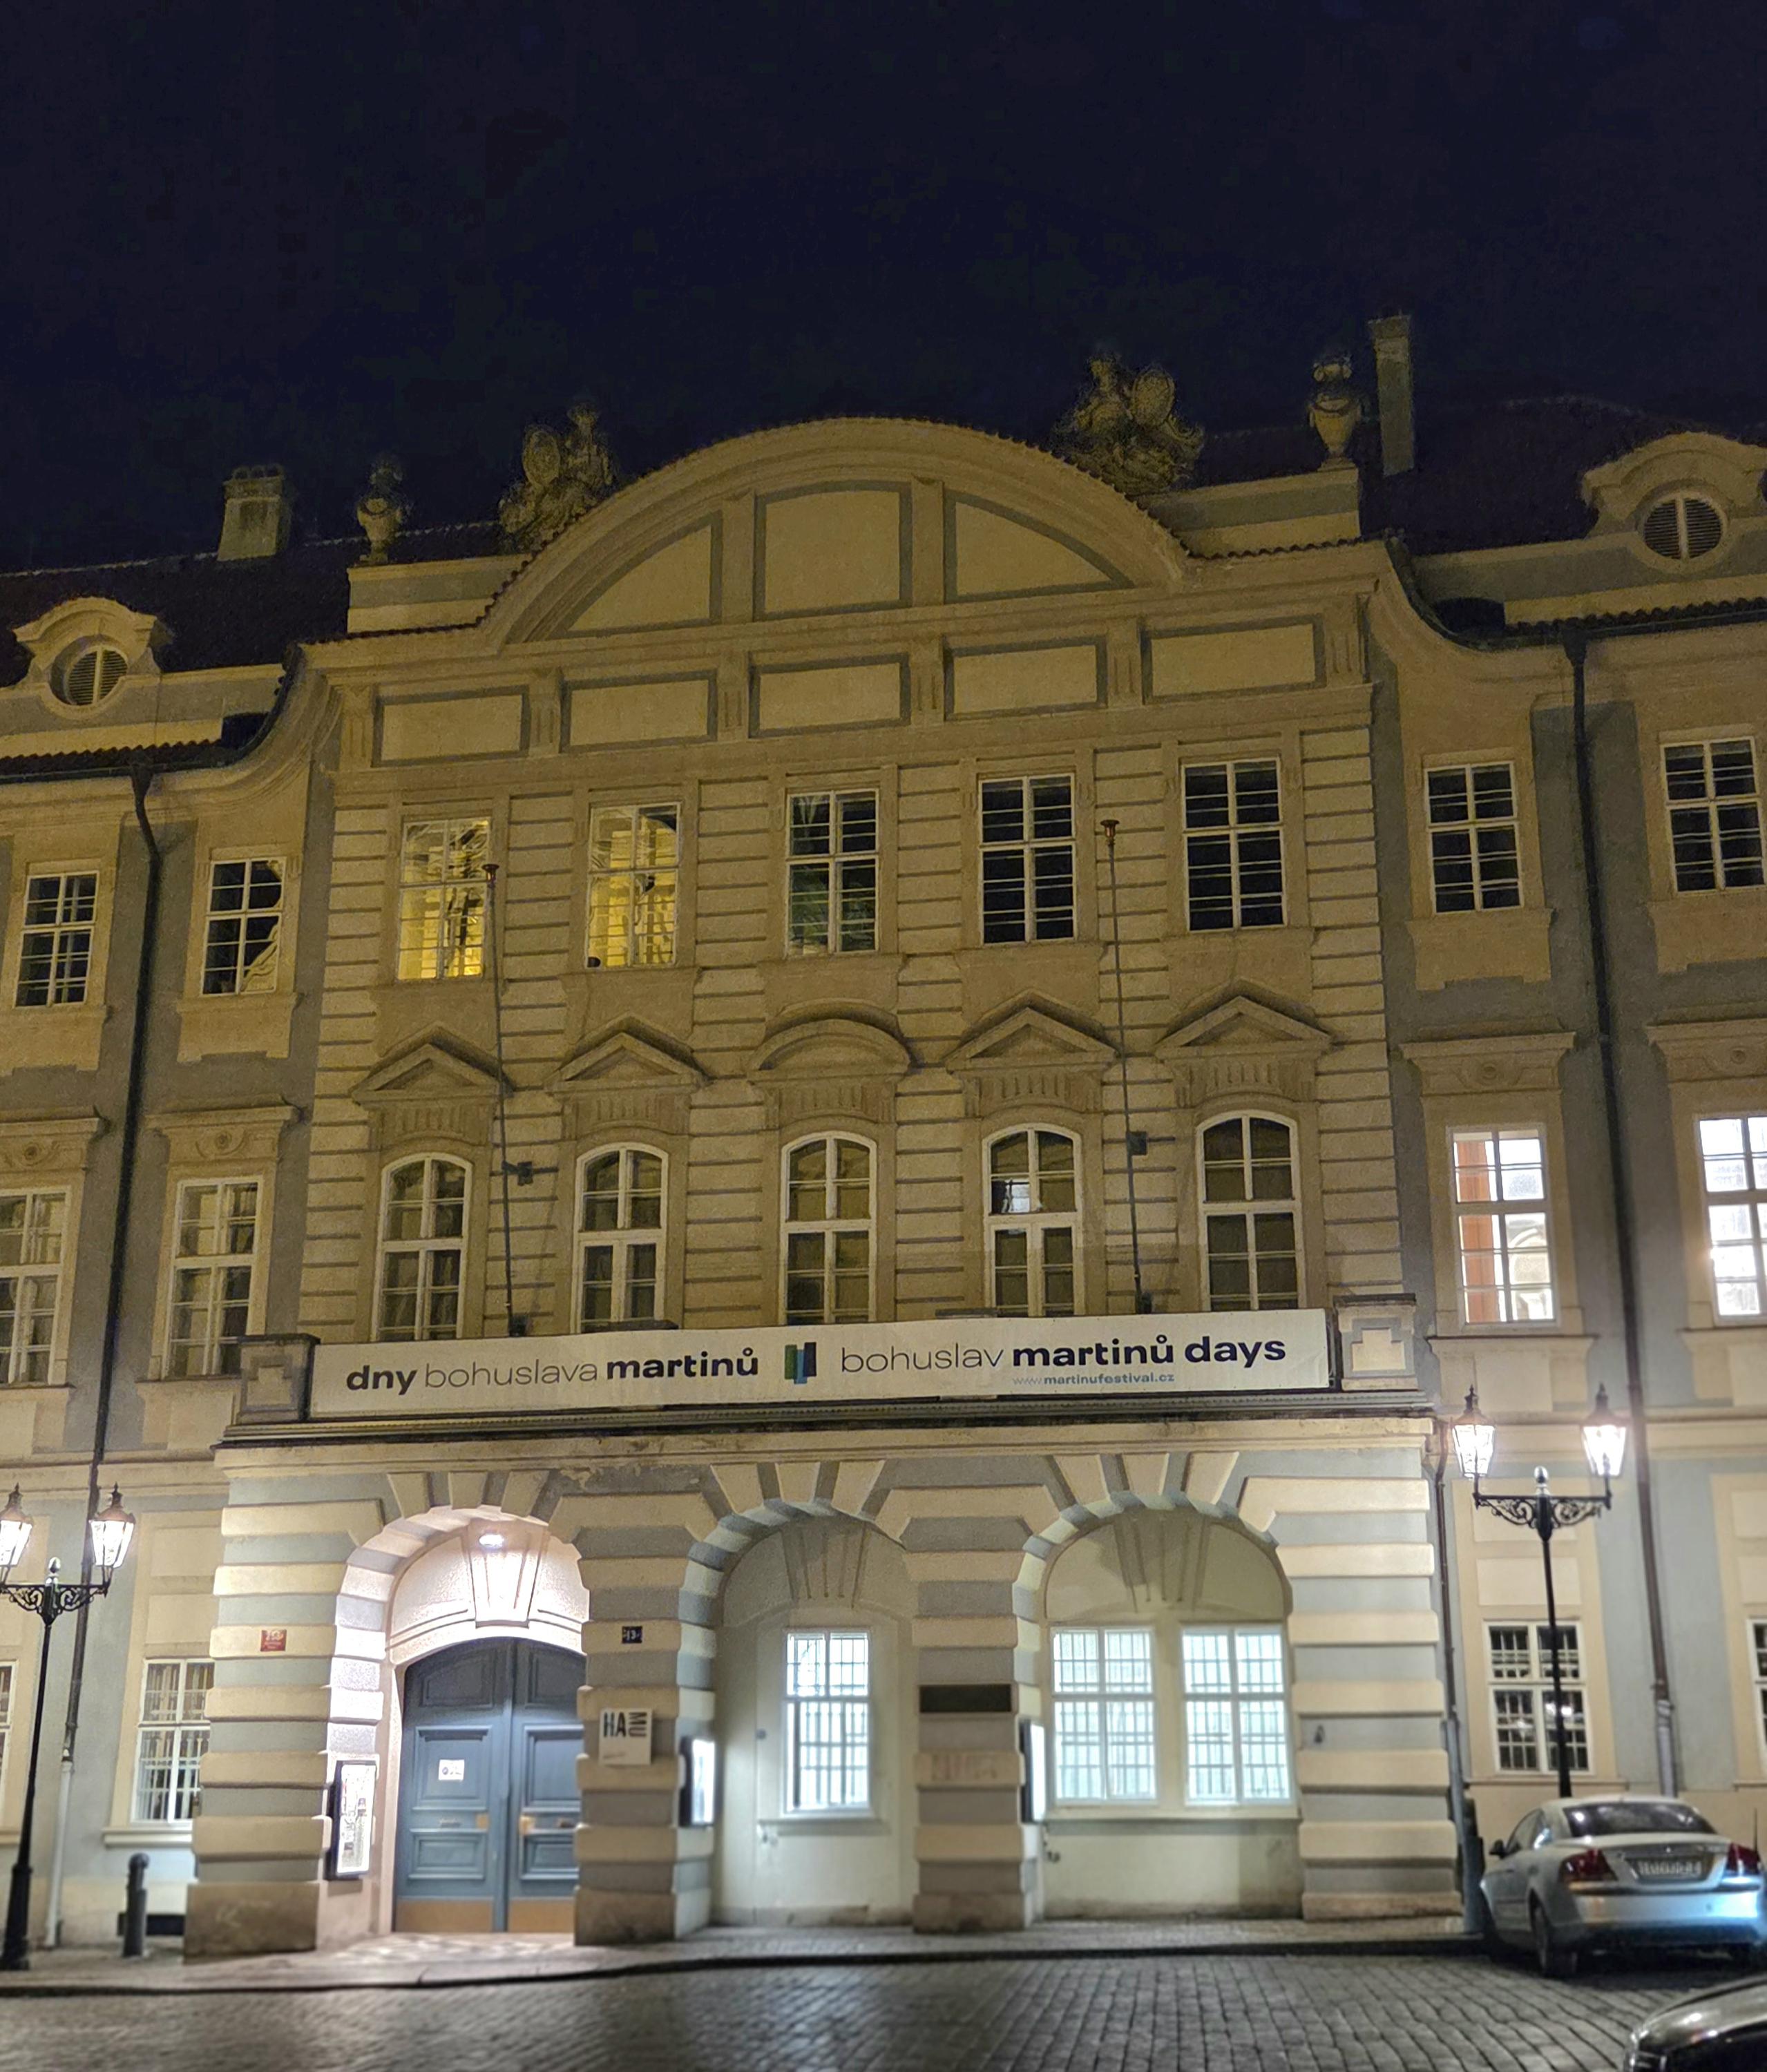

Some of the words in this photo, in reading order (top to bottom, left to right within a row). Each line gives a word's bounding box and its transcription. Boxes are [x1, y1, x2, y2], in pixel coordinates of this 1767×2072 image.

[346, 1365, 417, 1394] dny
[424, 1360, 598, 1388] bohuslava
[606, 1347, 758, 1379] martinů
[841, 1343, 1004, 1372] bohuslav
[1012, 1334, 1174, 1367] martinů
[1183, 1336, 1286, 1368] days
